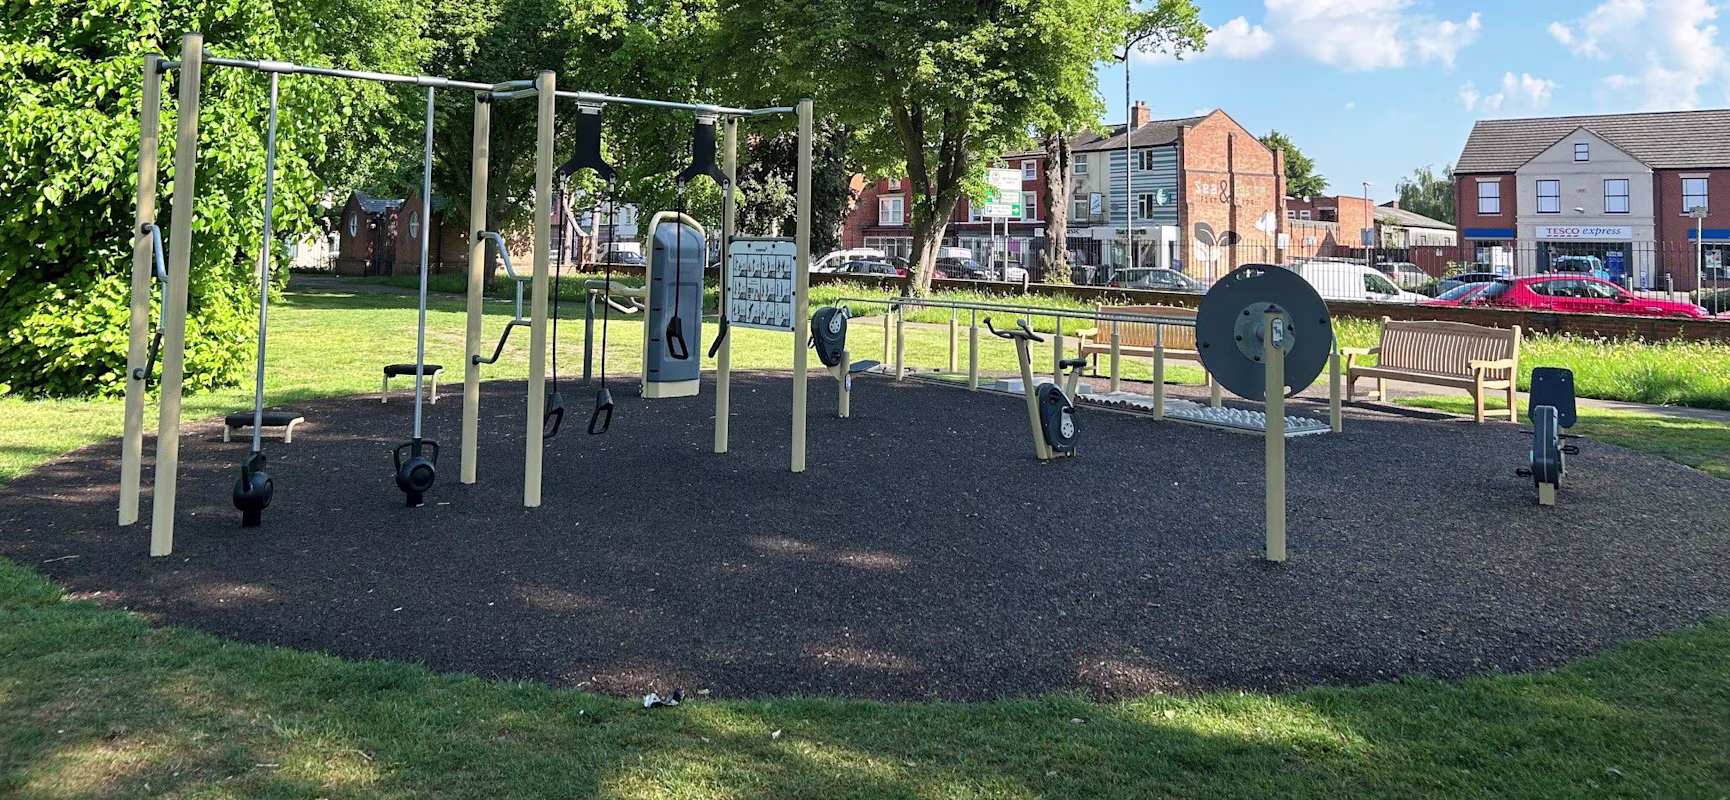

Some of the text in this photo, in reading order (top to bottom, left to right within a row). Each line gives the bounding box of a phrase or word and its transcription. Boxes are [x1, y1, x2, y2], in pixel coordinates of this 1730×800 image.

[1194, 180, 1218, 195] Sea
[1546, 227, 1621, 236] TESCO express
